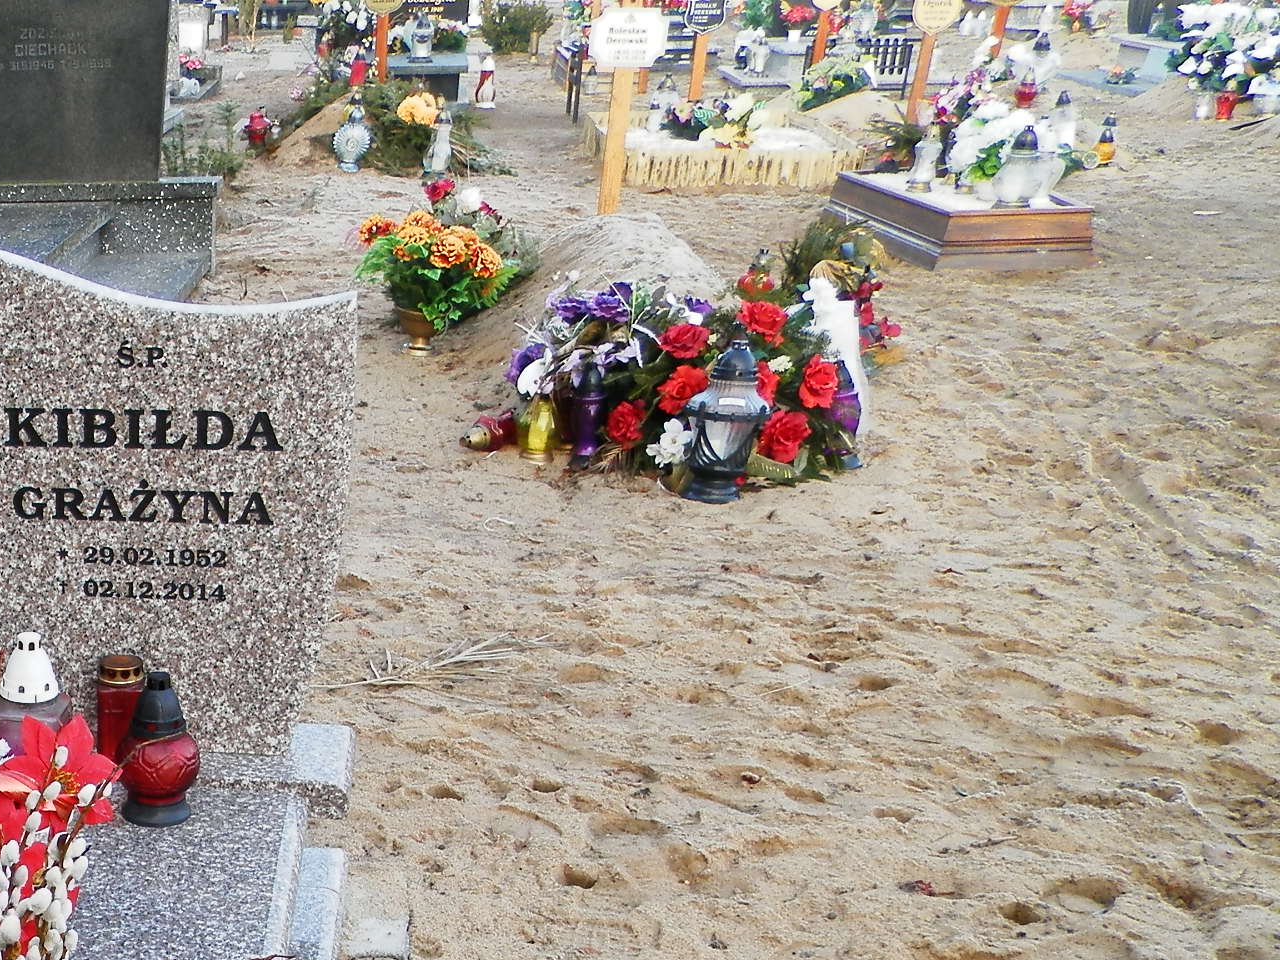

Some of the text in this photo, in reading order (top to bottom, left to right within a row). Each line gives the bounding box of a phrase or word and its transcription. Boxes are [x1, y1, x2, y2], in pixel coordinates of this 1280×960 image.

[117, 340, 169, 369] Ś.P.
[4, 406, 284, 451] KIBIŁDA
[12, 478, 274, 526] GRAŻYNA
[83, 546, 227, 568] 29.02.1952
[83, 580, 227, 601] 02.12.2014
